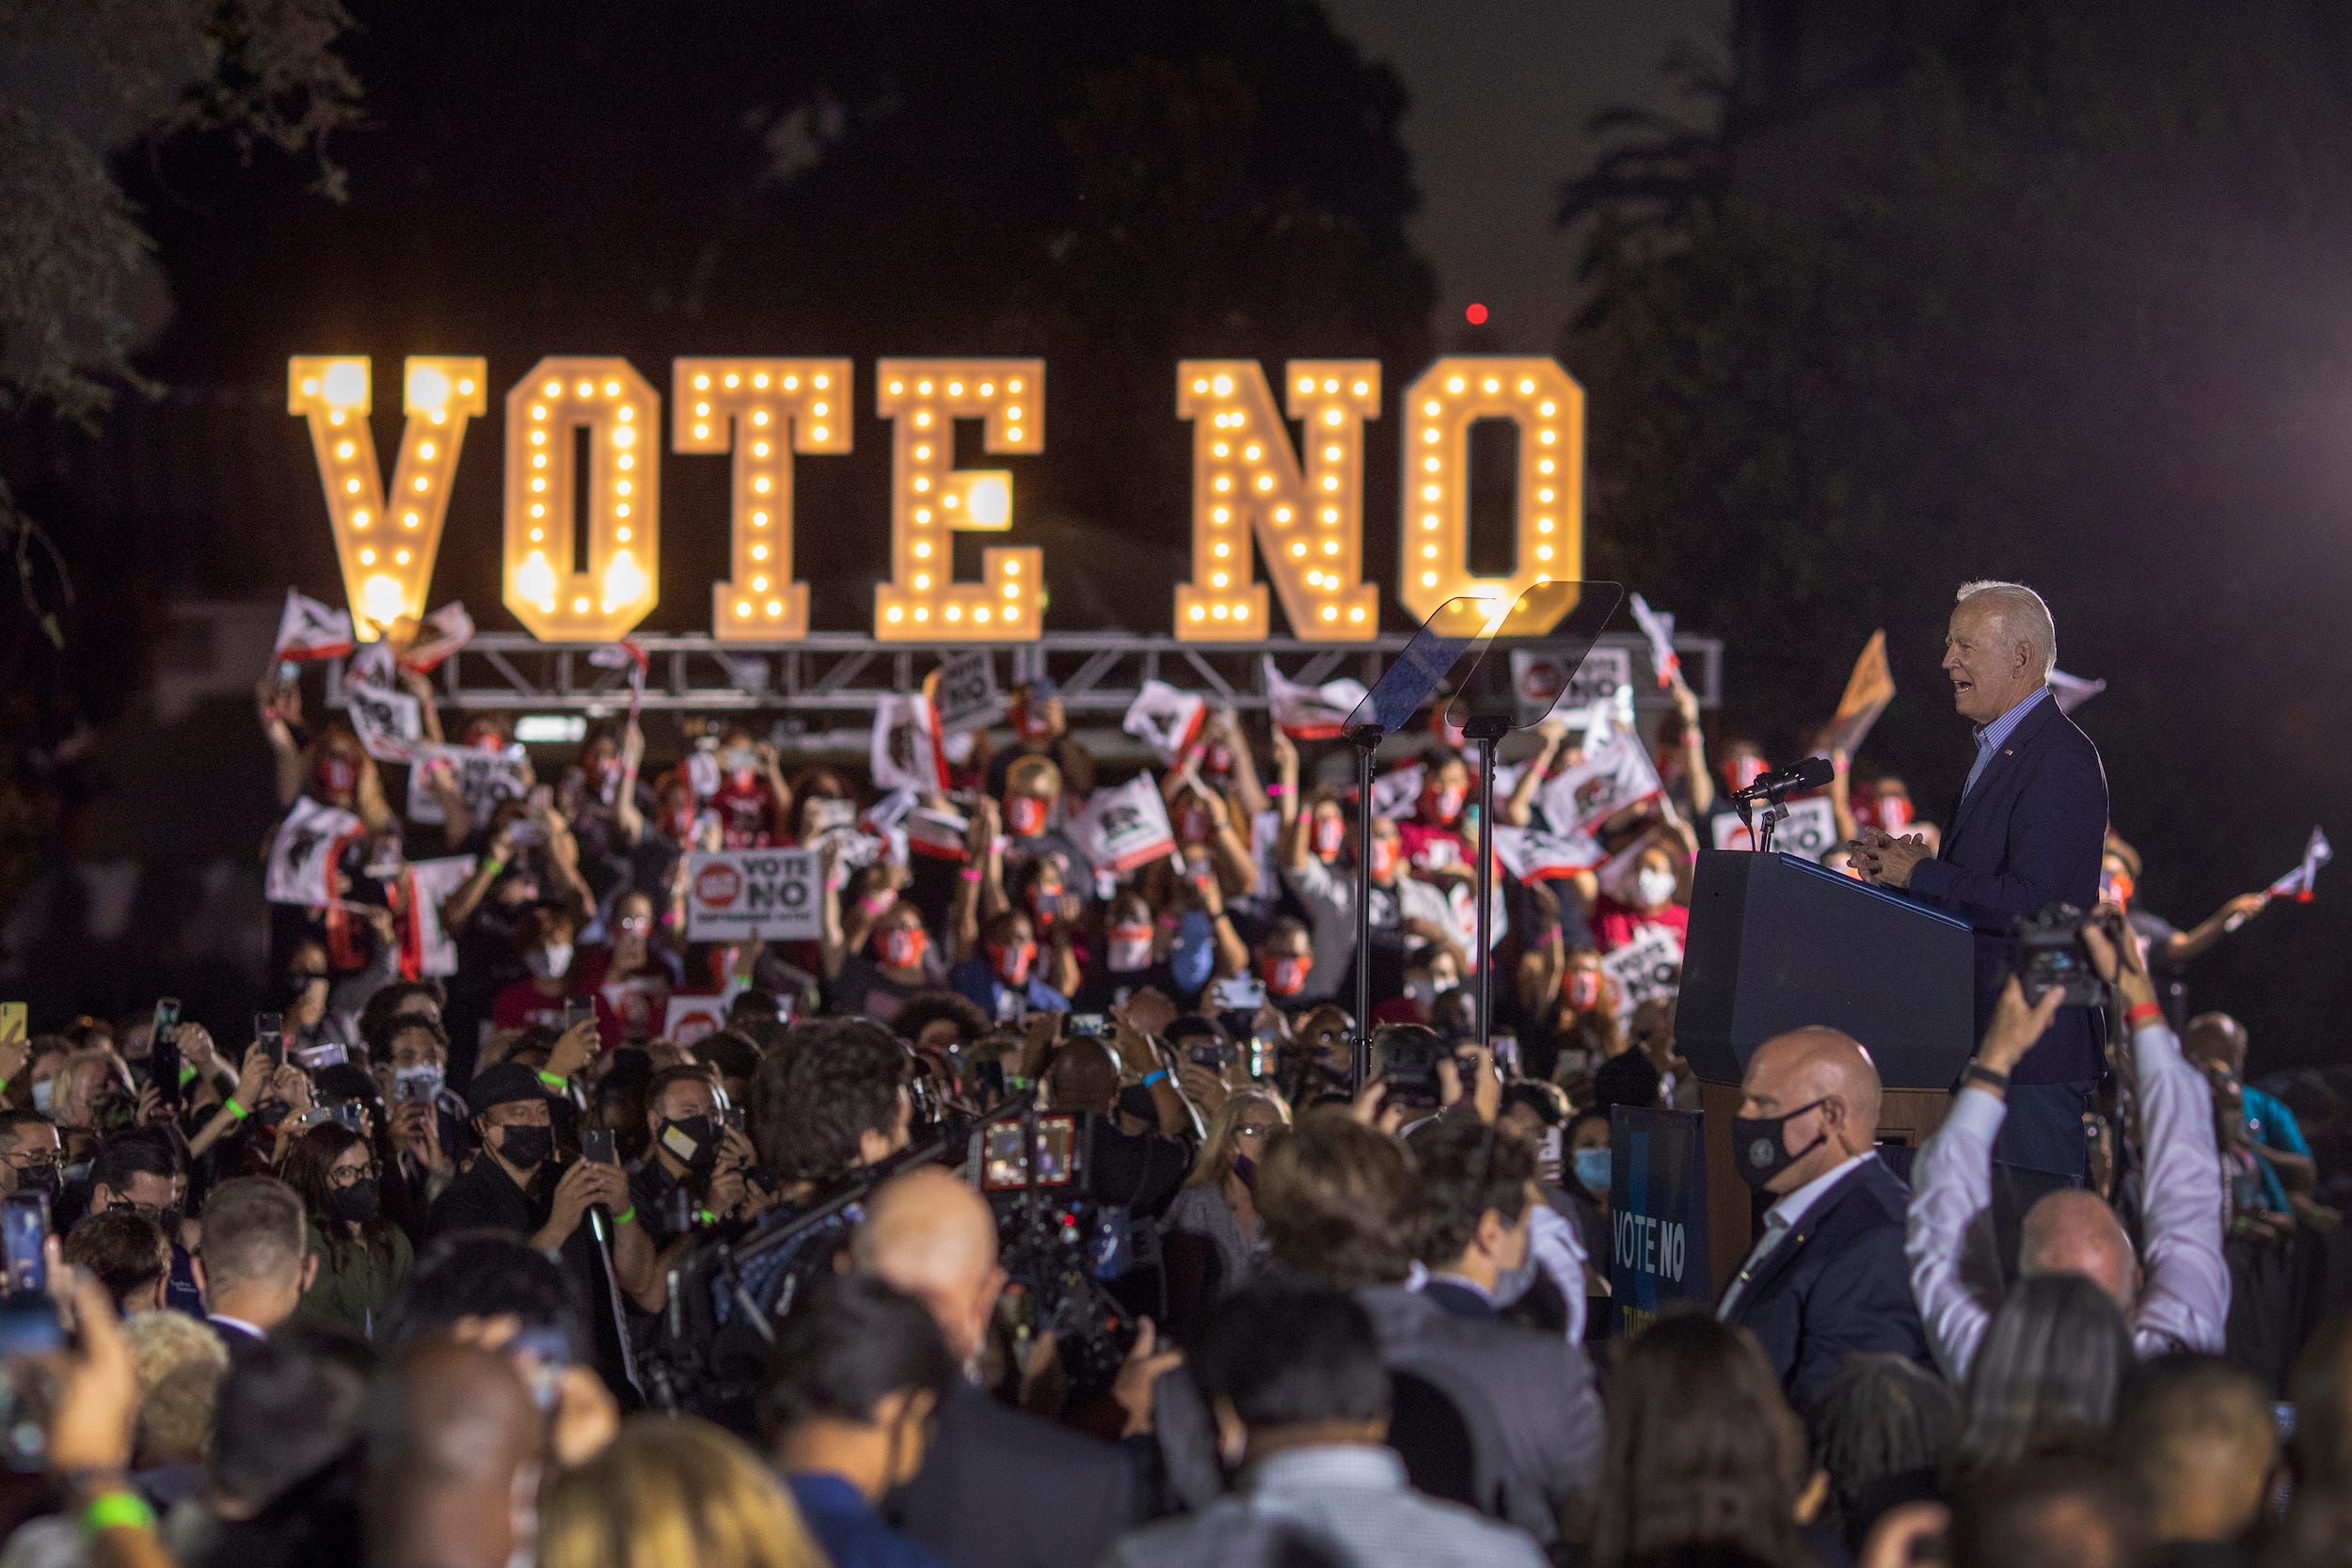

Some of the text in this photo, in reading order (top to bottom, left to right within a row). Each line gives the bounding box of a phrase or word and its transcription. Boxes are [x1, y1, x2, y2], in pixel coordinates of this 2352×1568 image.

[286, 355, 1586, 643] VOTE NO
[741, 857, 809, 876] VOTE
[747, 879, 807, 908] NO
[1626, 960, 1677, 999] NO
[1613, 1209, 1686, 1283] VOTE NO
